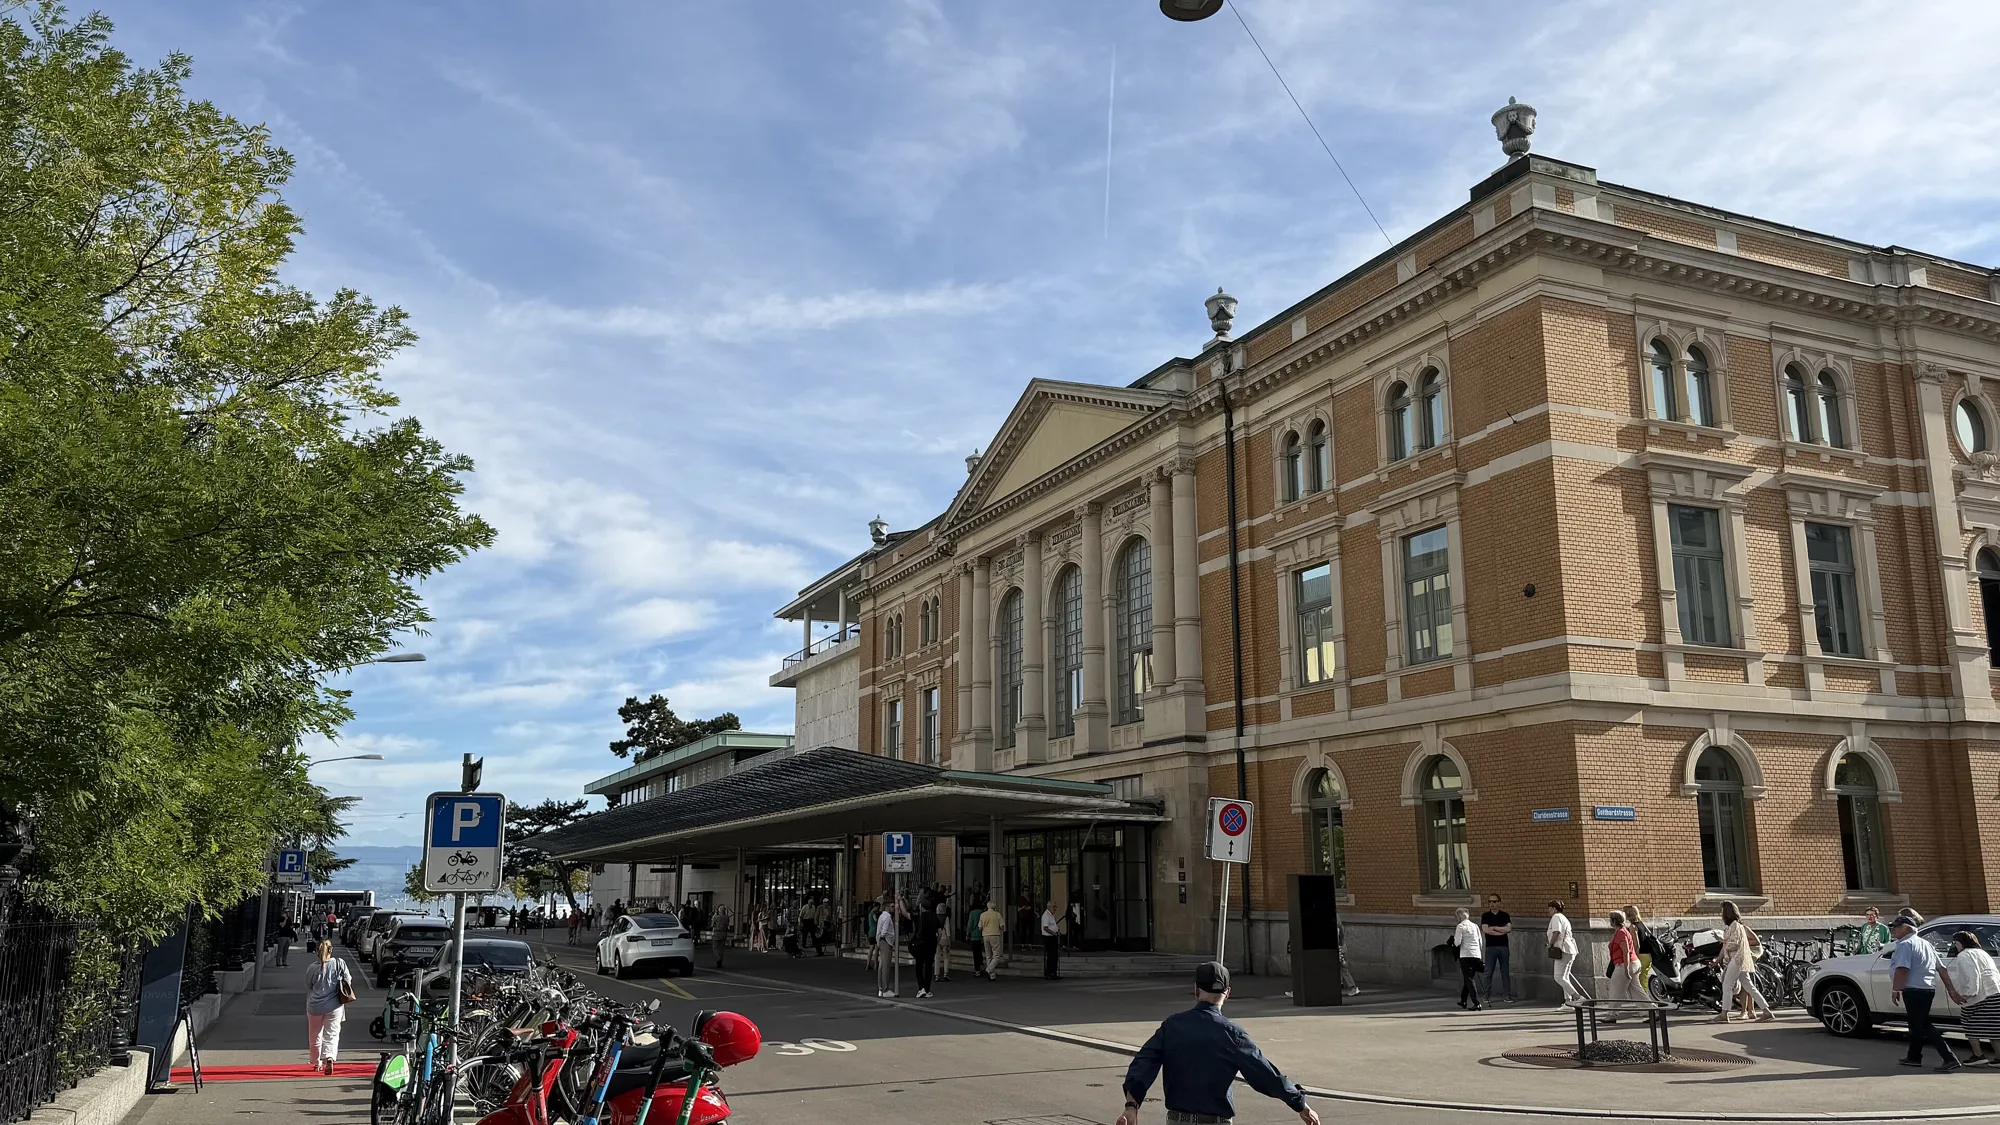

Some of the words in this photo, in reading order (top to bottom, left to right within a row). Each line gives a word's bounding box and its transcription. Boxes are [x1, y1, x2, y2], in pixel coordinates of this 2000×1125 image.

[1533, 811, 1568, 820] Claridenstrasse
[1596, 808, 1634, 817] Gotthardstrasse
[451, 802, 481, 842] P
[892, 834, 904, 853] P
[285, 853, 298, 870] P
[760, 1038, 858, 1056] 30
[682, 1097, 696, 1118] Bolt
